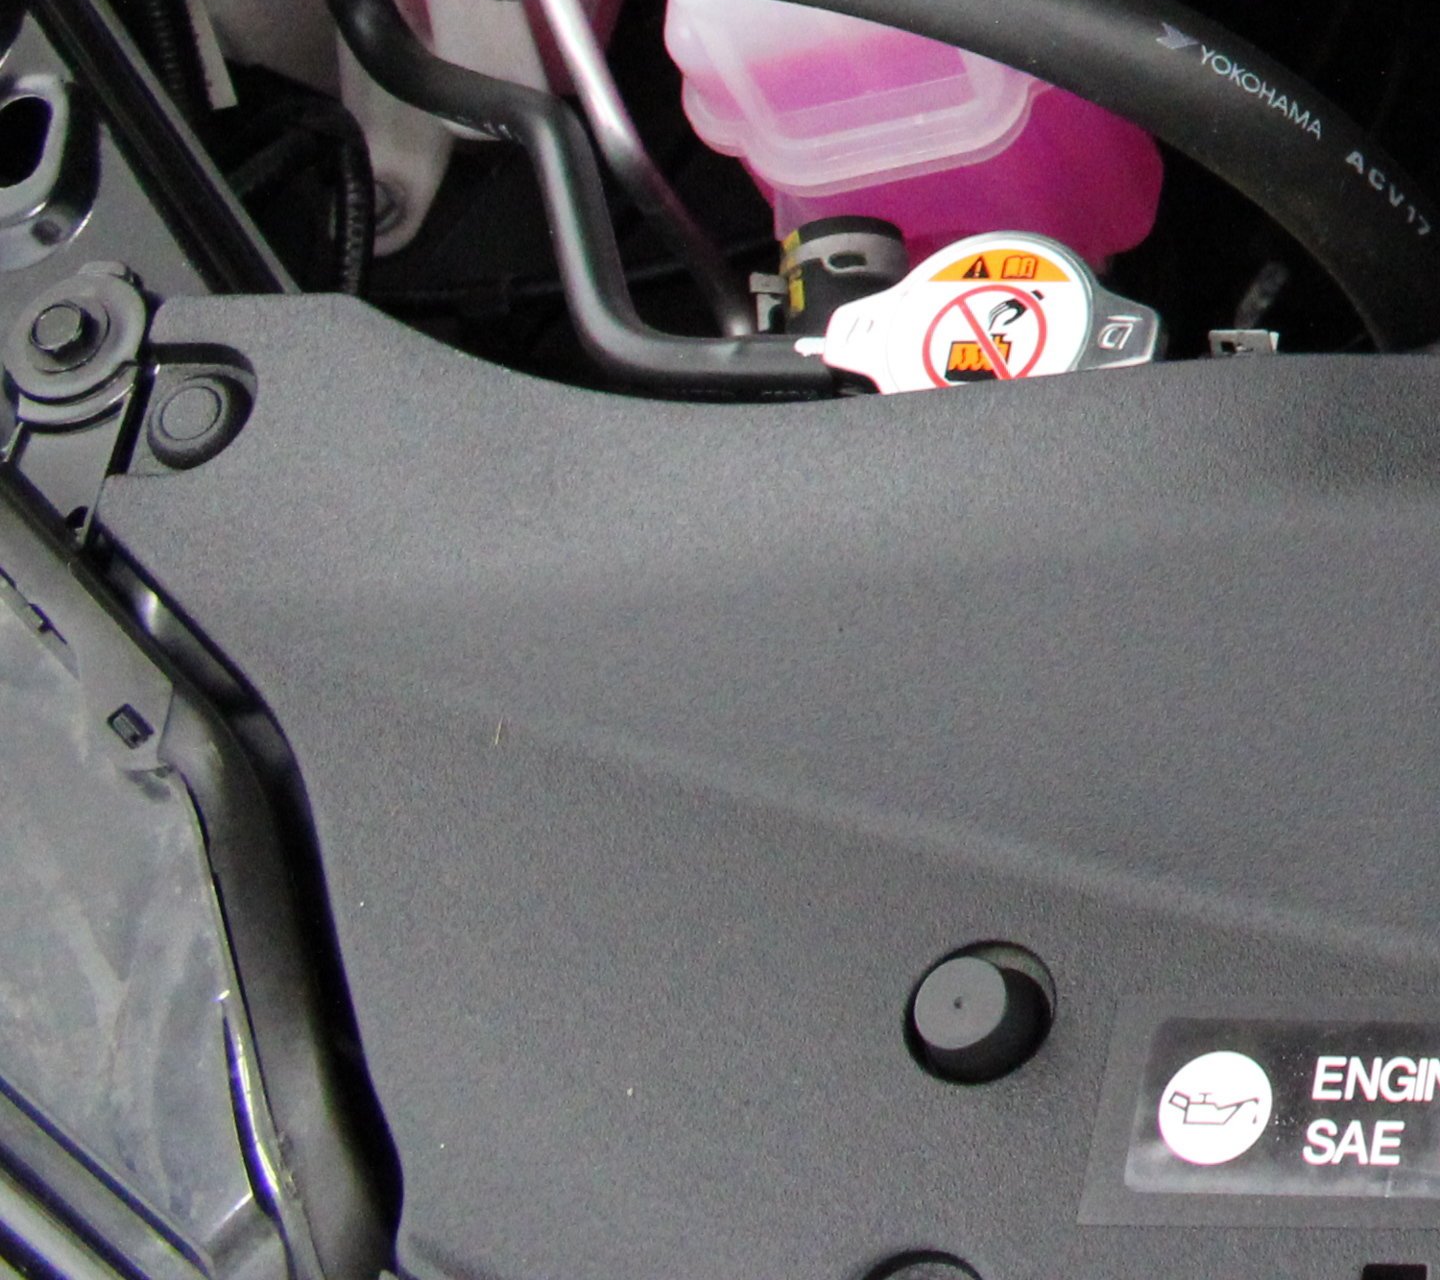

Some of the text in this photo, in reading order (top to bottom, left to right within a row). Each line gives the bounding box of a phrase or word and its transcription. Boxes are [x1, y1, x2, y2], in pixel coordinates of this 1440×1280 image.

[1201, 44, 1322, 140] YOKOHAMA
[1345, 150, 1432, 236] ACV17
[1301, 1118, 1406, 1167] SAE
